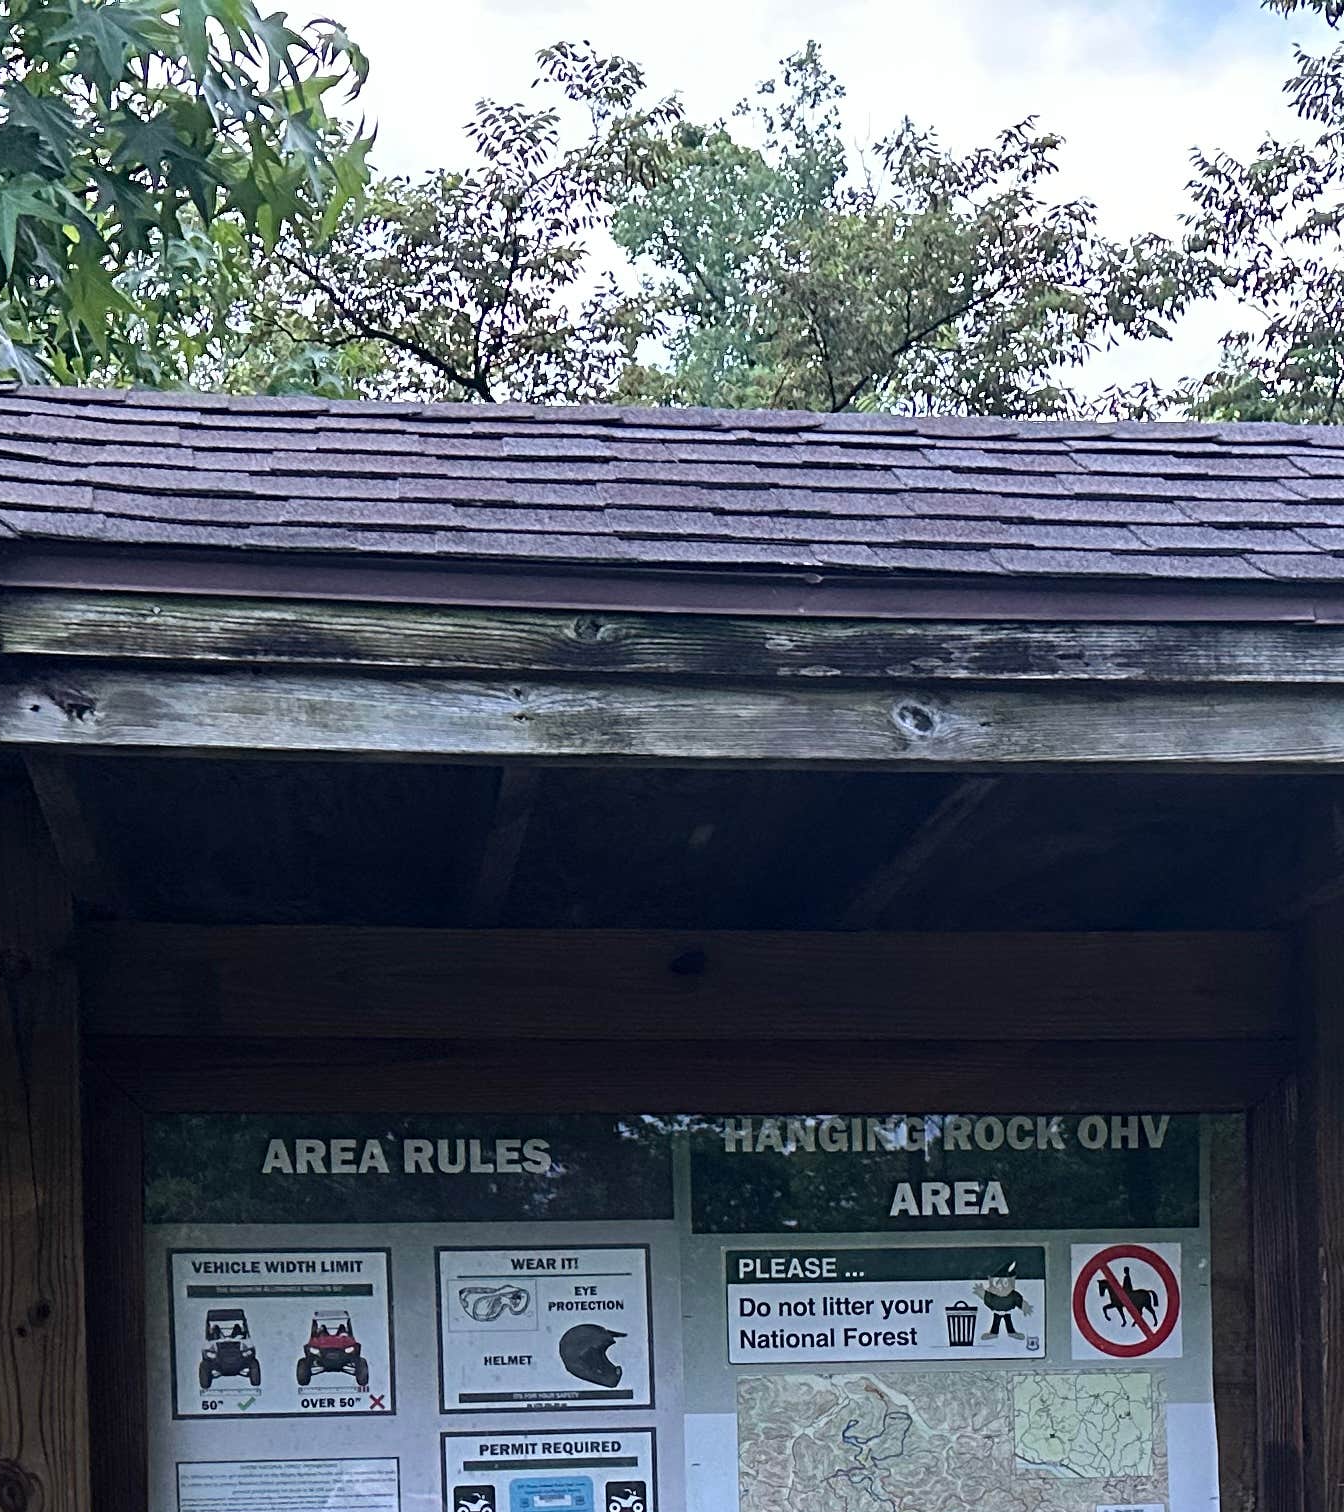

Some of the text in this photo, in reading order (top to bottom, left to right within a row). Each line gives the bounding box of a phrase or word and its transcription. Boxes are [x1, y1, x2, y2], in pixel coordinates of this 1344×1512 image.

[724, 1115, 1170, 1152] HANGING ROCK OHV
[262, 1138, 552, 1174] AREA RULES
[889, 1181, 1010, 1217] AREA
[191, 1260, 363, 1274] VEHICLE WIDTH LIMIT
[510, 1257, 579, 1270] WEAR IT!
[739, 1257, 838, 1279] PLEASE
[574, 1285, 598, 1296] EYE
[548, 1300, 624, 1312] PROTECTION
[739, 1296, 934, 1320] Do not litter your
[740, 1327, 918, 1349] National Forest
[484, 1355, 533, 1366] HELMET
[301, 1397, 336, 1409] OVER
[479, 1440, 622, 1456] PERMIT REQUIRED
